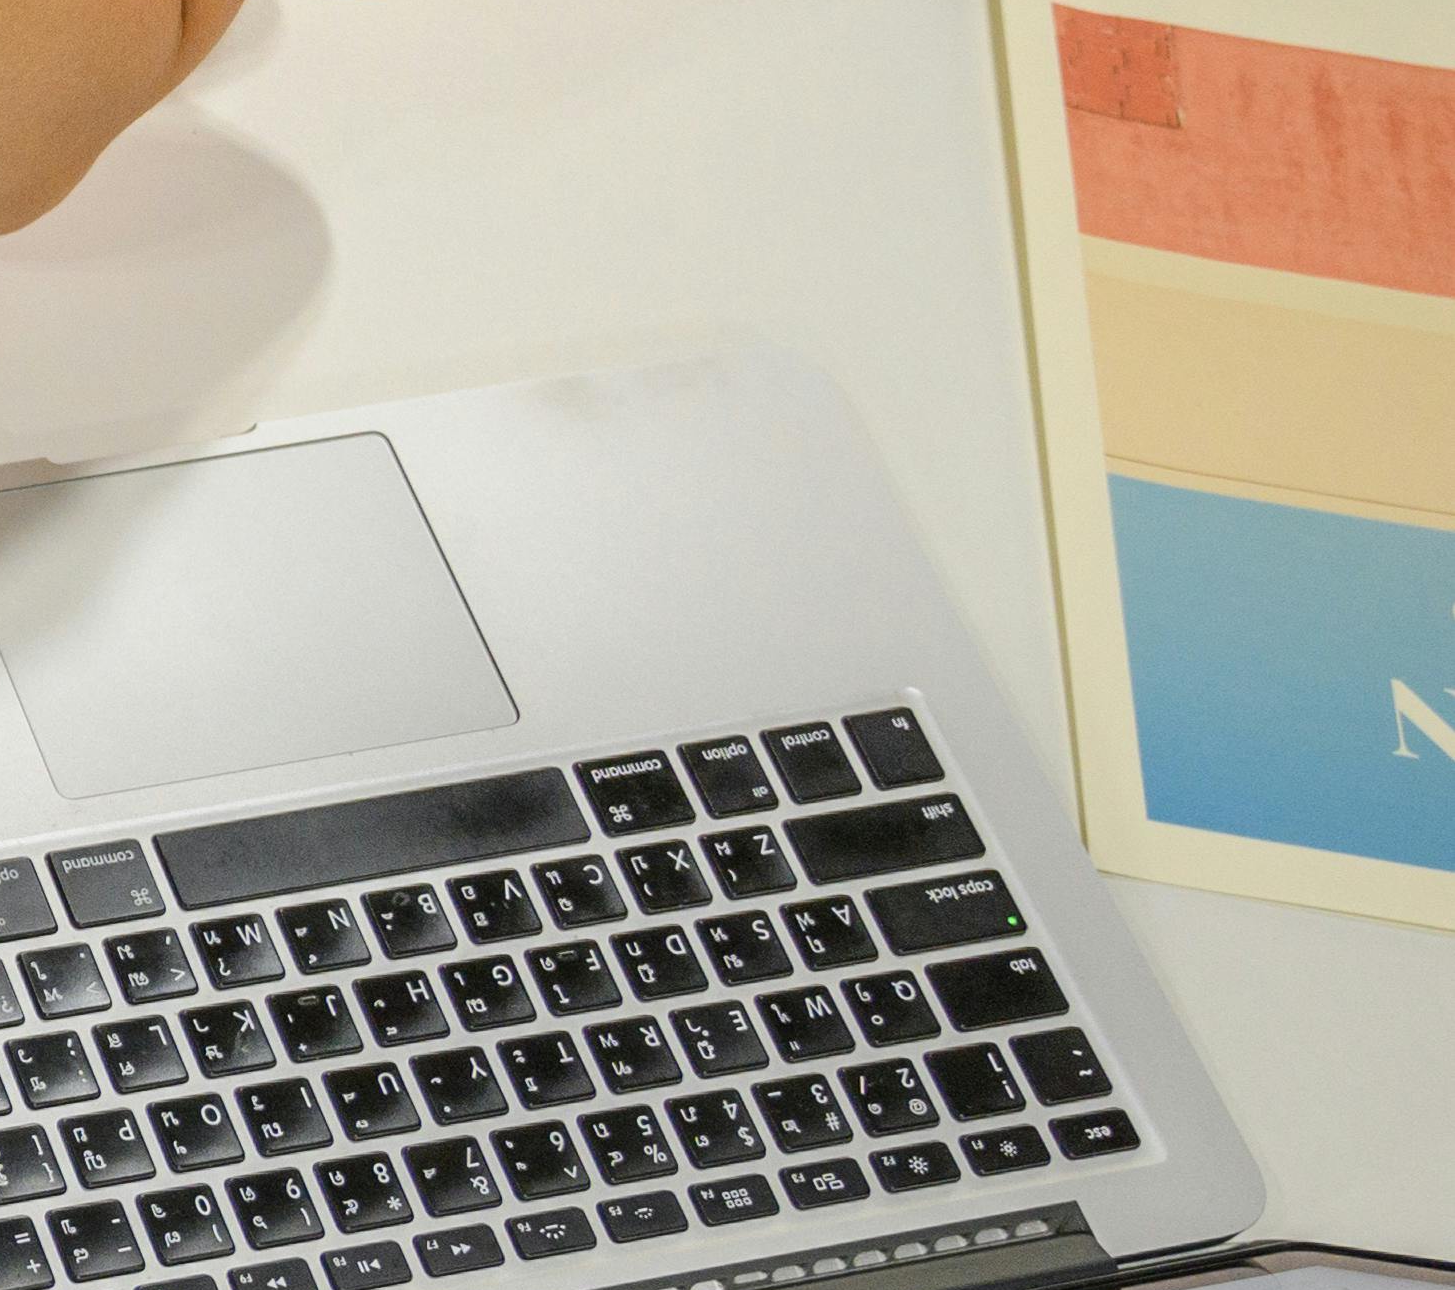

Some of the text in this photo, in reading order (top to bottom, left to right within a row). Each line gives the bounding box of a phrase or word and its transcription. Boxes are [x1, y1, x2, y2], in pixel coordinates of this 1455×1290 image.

[890, 715, 909, 730] fn
[779, 728, 830, 750] control
[700, 741, 748, 761] option
[589, 757, 662, 784] command
[920, 801, 954, 820] shift
[751, 832, 775, 856] Z
[60, 848, 135, 874] command
[665, 847, 690, 871] X
[581, 863, 604, 885] C
[502, 877, 522, 900] V
[923, 878, 994, 903] caps lock
[416, 892, 437, 914] B
[829, 903, 851, 926] A
[325, 906, 351, 930] N
[750, 918, 770, 941] S
[234, 921, 262, 946] M
[664, 932, 687, 955] D
[584, 947, 601, 971] F
[1008, 957, 1037, 975] tab
[490, 963, 513, 986] G
[404, 978, 430, 1003] H
[889, 979, 916, 1001] Q
[324, 993, 337, 1017] J
[803, 994, 832, 1018] W
[231, 1008, 255, 1032] K
[727, 1008, 748, 1032] E
[147, 1023, 168, 1046] L
[637, 1024, 661, 1047] R
[555, 1040, 574, 1063] T
[985, 1051, 1003, 1073] 1
[468, 1055, 488, 1079] Y
[894, 1066, 915, 1088] 2
[376, 1070, 400, 1095] U
[809, 1082, 828, 1104] 3
[298, 1085, 312, 1108] I
[199, 1102, 222, 1126] O
[721, 1098, 738, 1120] 4
[117, 1117, 135, 1141] P
[635, 1113, 653, 1136] 5
[1083, 1124, 1112, 1140] esc
[548, 1130, 565, 1152] 6
[969, 1138, 984, 1150] F1
[465, 1145, 480, 1168] 7
[880, 1154, 896, 1167] F2
[371, 1161, 390, 1184] 8
[789, 1171, 806, 1184] F3
[284, 1176, 301, 1199] 9
[699, 1188, 715, 1200] F4
[193, 1193, 211, 1216] 0
[607, 1204, 622, 1217] F5
[515, 1221, 532, 1233] F6
[425, 1238, 439, 1250] F7
[331, 1255, 347, 1267] F8
[238, 1272, 253, 1284] F9
